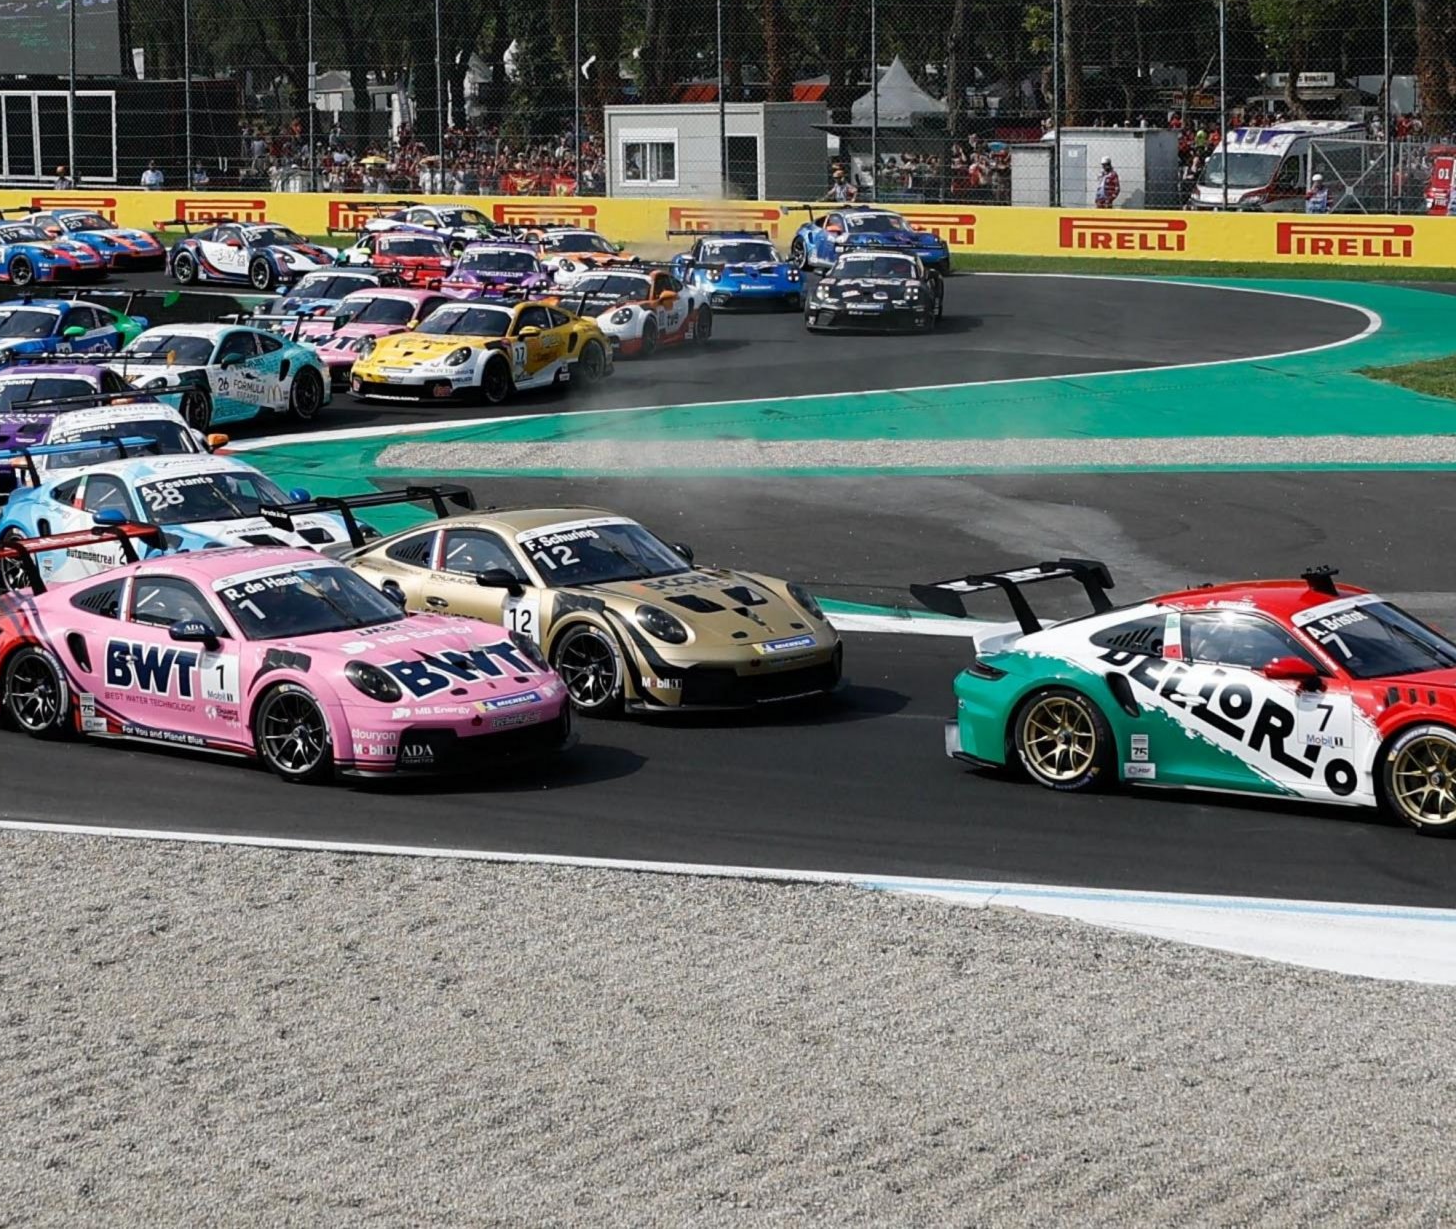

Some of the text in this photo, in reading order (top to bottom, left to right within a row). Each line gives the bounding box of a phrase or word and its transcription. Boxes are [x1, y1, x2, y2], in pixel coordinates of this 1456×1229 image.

[1438, 168, 1450, 179] 01
[66, 220, 82, 230] 20
[1059, 216, 1187, 252] PIRELLI
[1276, 221, 1415, 258] PIRELLI
[514, 347, 525, 360] 17
[218, 377, 229, 391] 26
[233, 379, 265, 394] FORMULA
[142, 485, 156, 497] A.
[146, 488, 185, 511] 28
[525, 528, 600, 552] F. Schuring
[66, 548, 116, 565] automontreal
[533, 545, 581, 570] 12
[224, 574, 304, 601] R. de Haan
[238, 599, 266, 620] 1
[509, 608, 532, 633] 12
[378, 634, 410, 646] MB
[412, 625, 473, 641] Energy
[1306, 626, 1329, 640] A.
[774, 638, 811, 650] MICHELIN
[1320, 632, 1353, 659] 7
[106, 639, 198, 700] BWT
[216, 664, 225, 690] 1
[378, 639, 540, 701] BWT
[641, 677, 670, 689] Mobil
[104, 691, 196, 712] BEST WATER TECHNOLOGY
[207, 690, 225, 700] Mobil
[496, 693, 536, 707] MICHELIN
[415, 705, 471, 716] MB Energy
[1317, 703, 1334, 732] 7
[122, 725, 134, 733] For
[135, 727, 148, 737] You
[149, 729, 163, 738] and
[164, 732, 186, 743] Planet
[352, 728, 396, 741] Nouryon
[1306, 734, 1333, 748] Mobil
[352, 744, 384, 756] Mobil
[402, 744, 434, 757] ADA
[1132, 747, 1148, 755] 75
